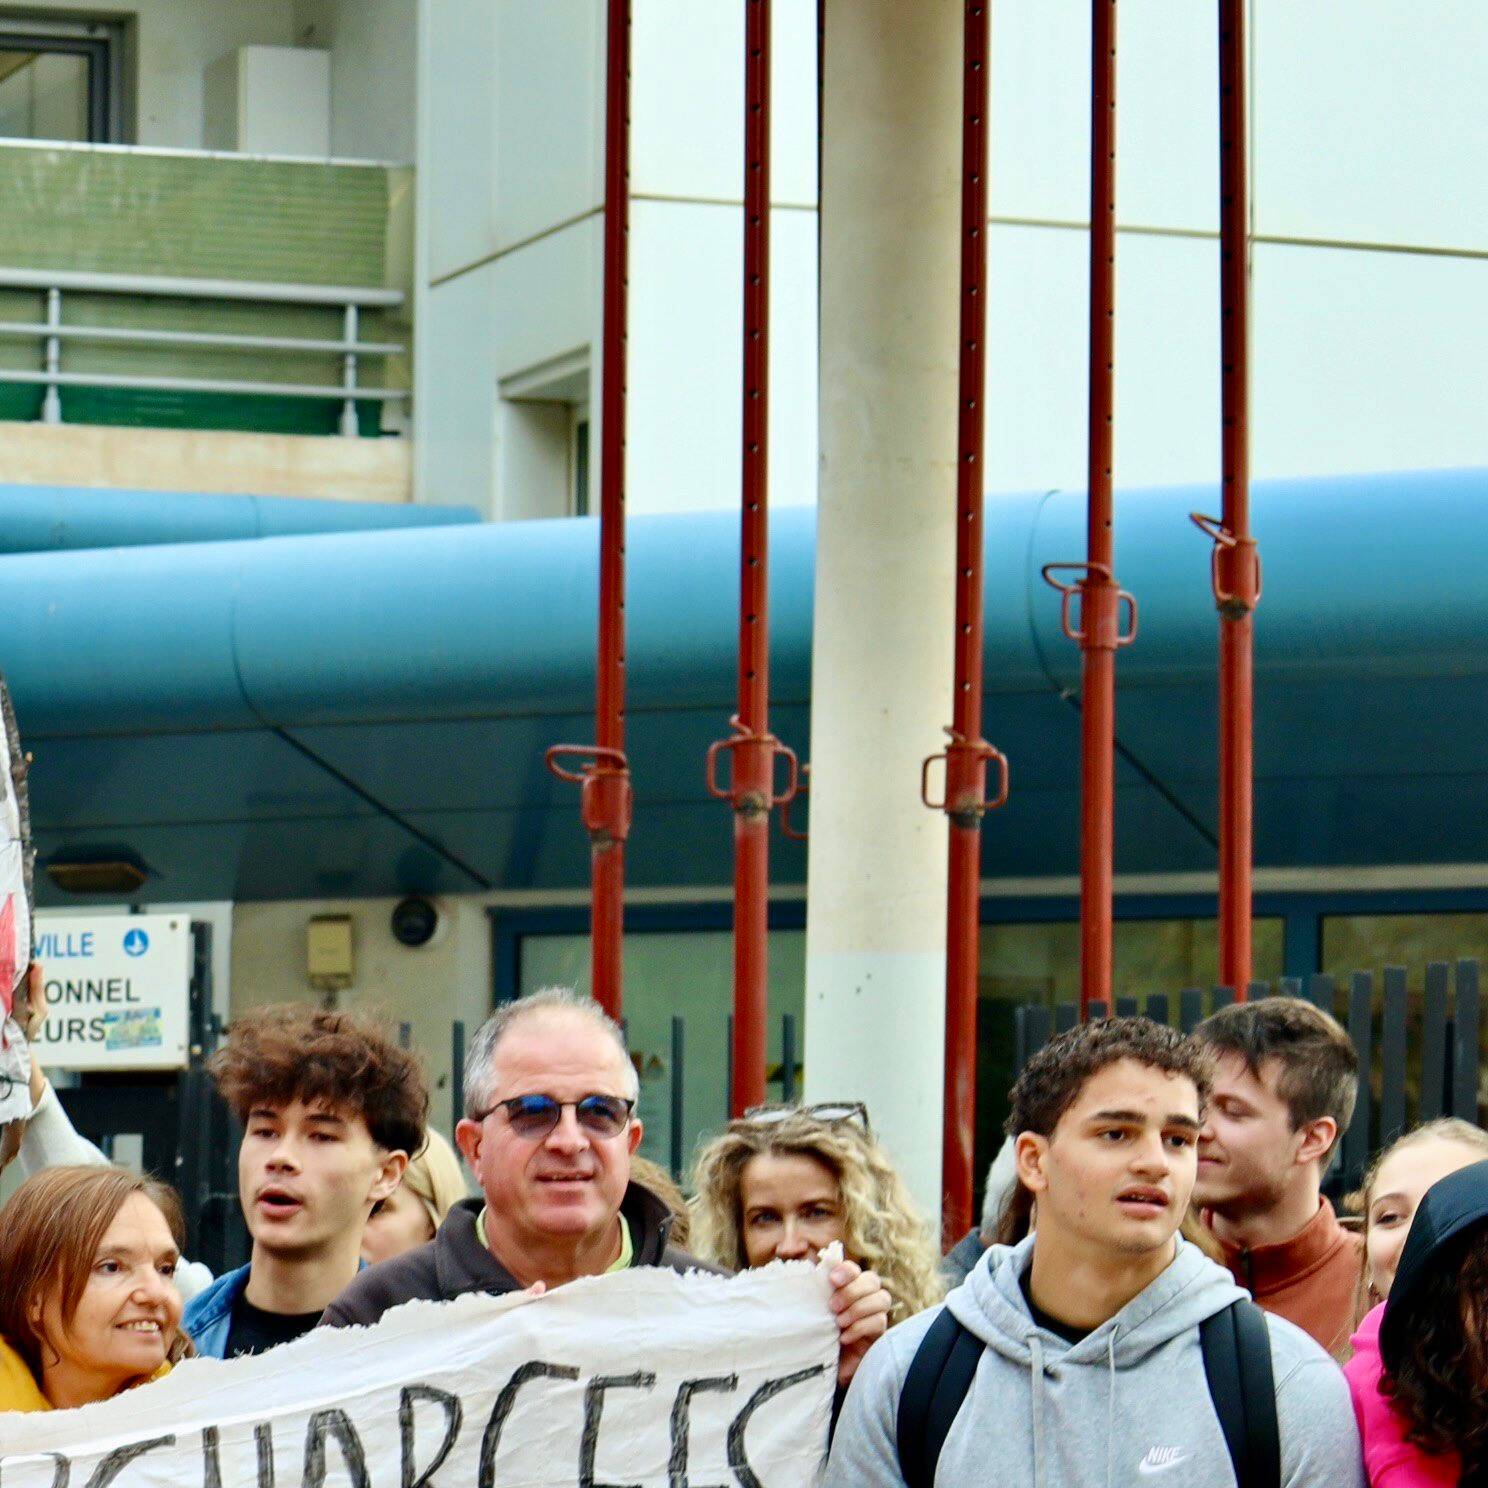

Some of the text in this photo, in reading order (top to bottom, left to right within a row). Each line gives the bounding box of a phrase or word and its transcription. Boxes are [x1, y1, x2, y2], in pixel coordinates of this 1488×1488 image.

[44, 979, 140, 1004] ONNEL
[32, 1017, 105, 1043] URS
[1147, 1445, 1182, 1464] NIKE
